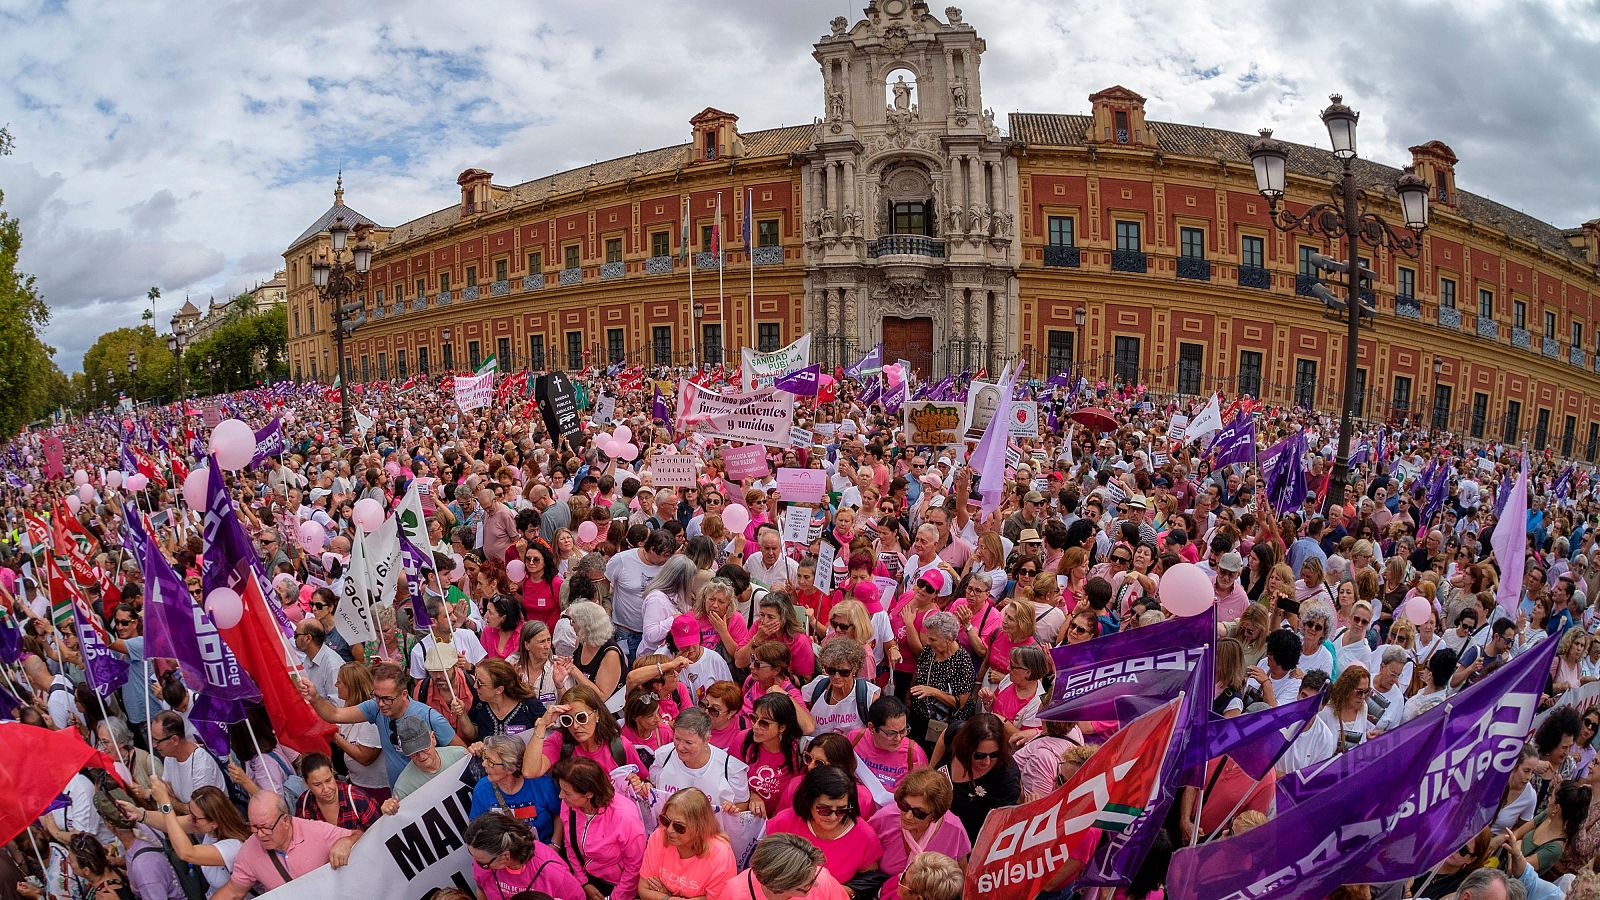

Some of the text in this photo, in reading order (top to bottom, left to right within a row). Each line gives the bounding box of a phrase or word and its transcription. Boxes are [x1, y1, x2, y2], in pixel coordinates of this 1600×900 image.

[752, 353, 788, 366] SANIDAD
[727, 418, 775, 432] y unidas
[815, 713, 857, 726] VOLUNTARI@
[858, 755, 906, 775] oluntari@
